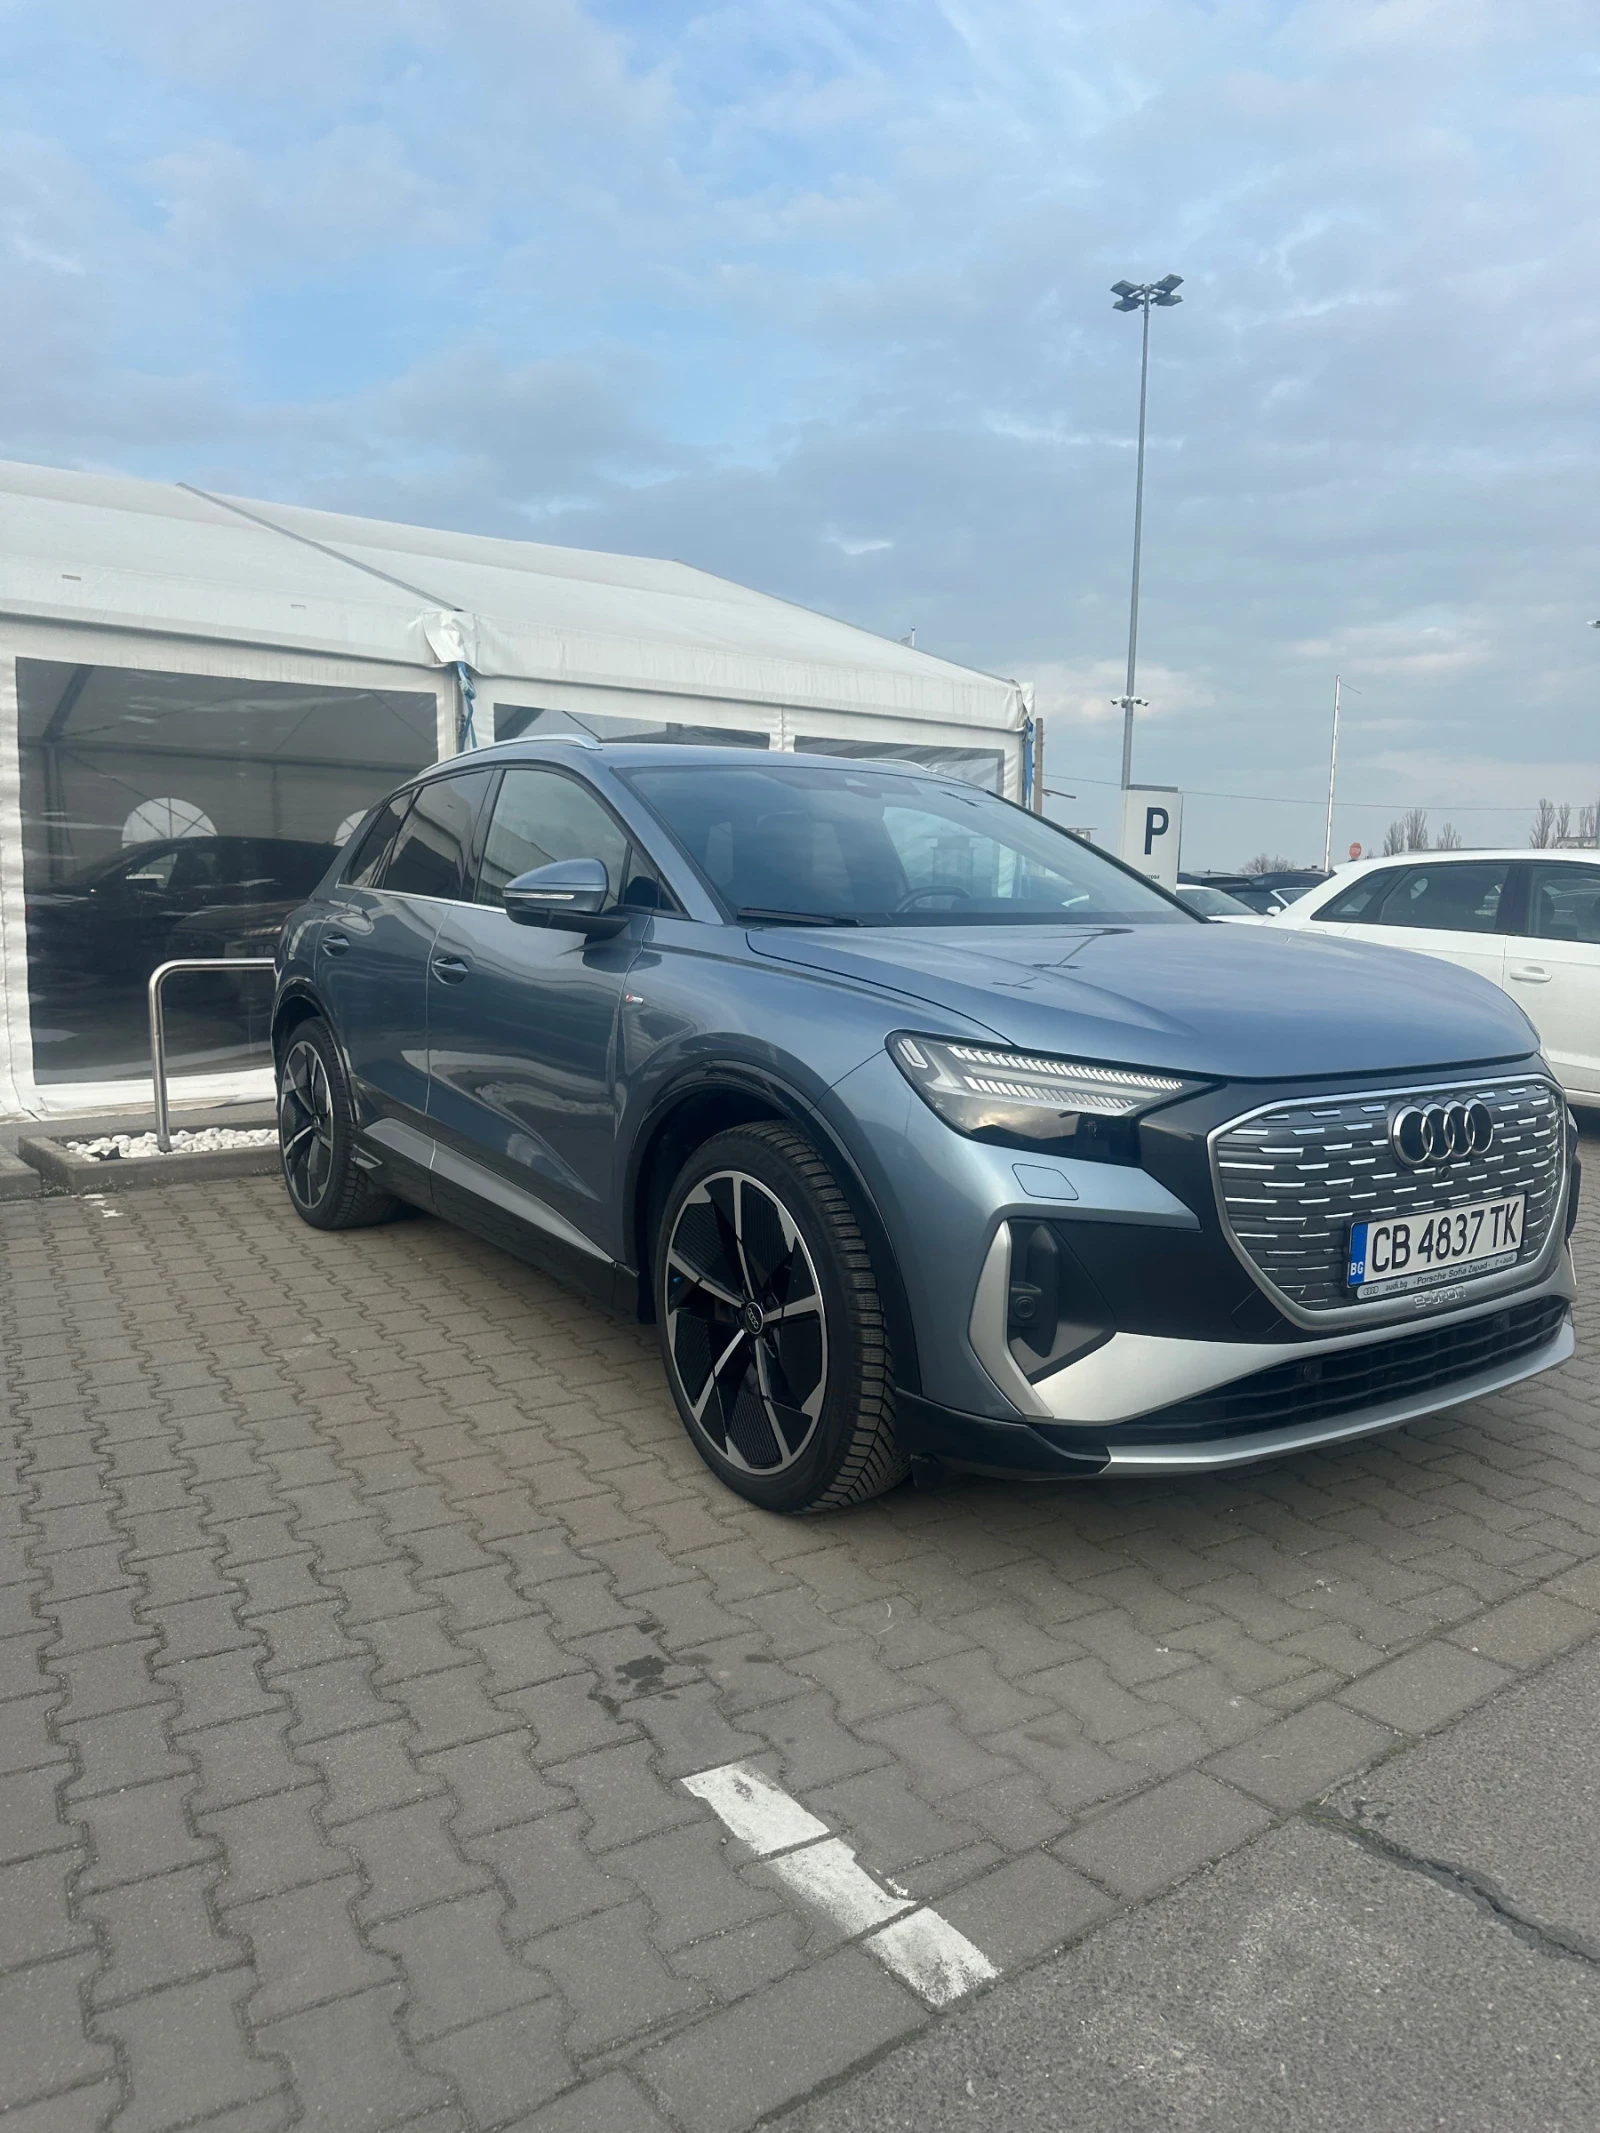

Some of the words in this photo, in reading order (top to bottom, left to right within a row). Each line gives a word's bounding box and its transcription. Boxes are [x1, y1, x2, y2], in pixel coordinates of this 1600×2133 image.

[1144, 807, 1169, 855] P
[1372, 1224, 1411, 1273] CB
[1418, 1209, 1485, 1264] 4837
[1490, 1201, 1520, 1248] TK
[1350, 1261, 1364, 1276] BG
[1449, 1266, 1467, 1278] Sofia
